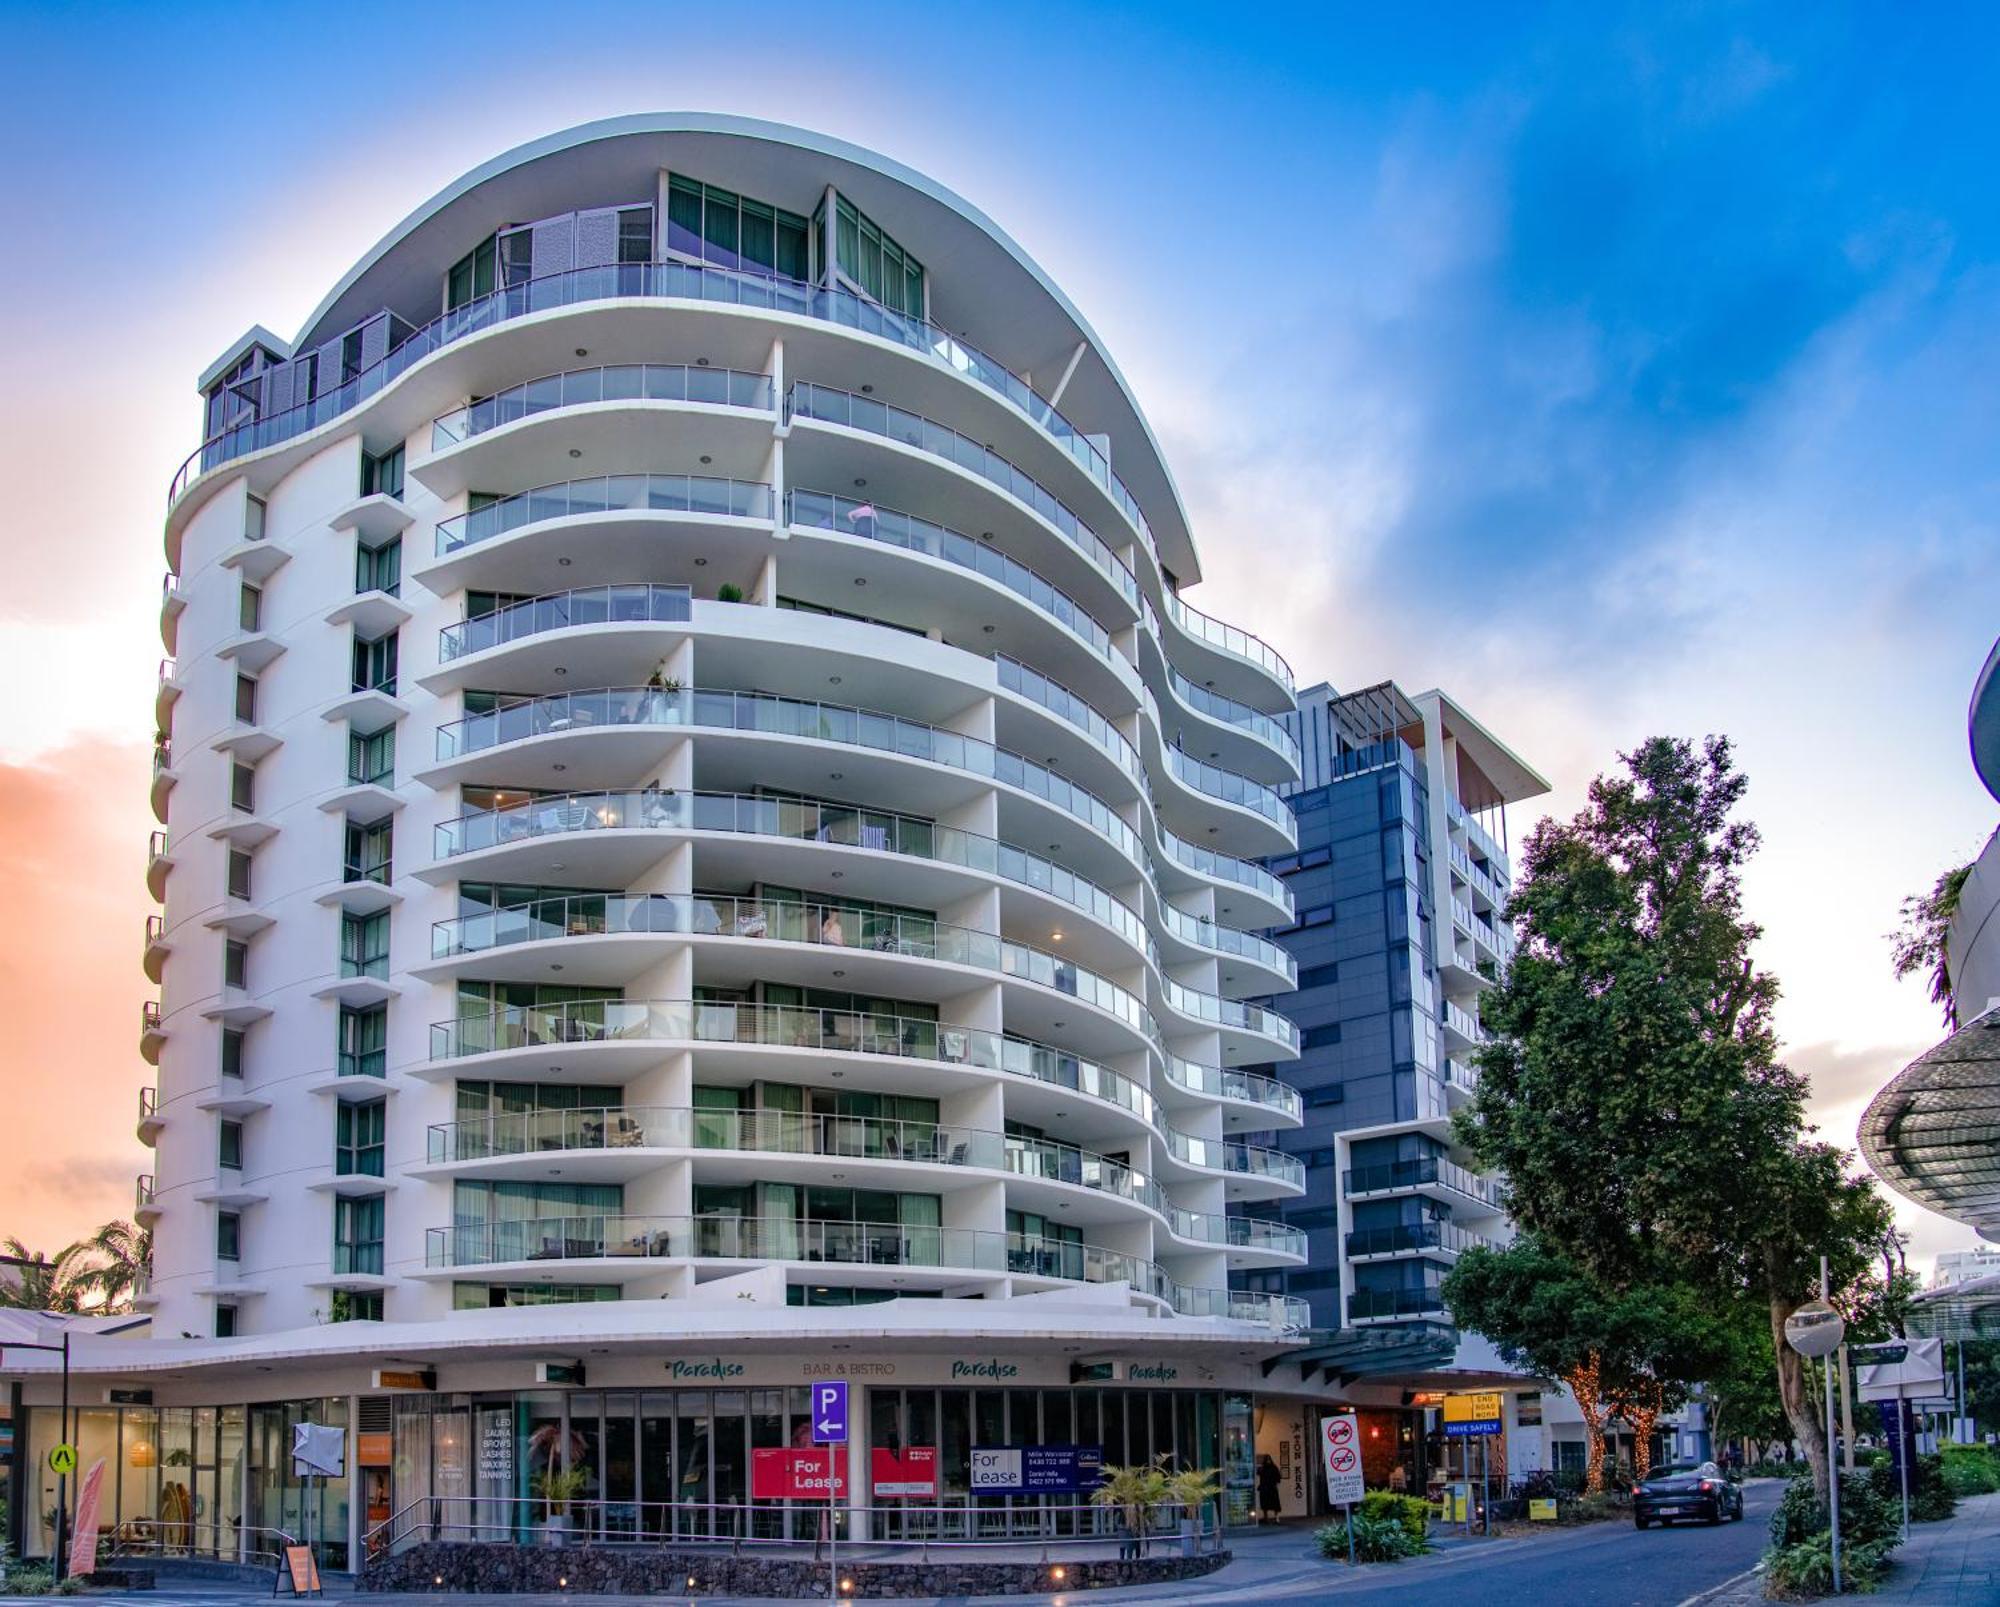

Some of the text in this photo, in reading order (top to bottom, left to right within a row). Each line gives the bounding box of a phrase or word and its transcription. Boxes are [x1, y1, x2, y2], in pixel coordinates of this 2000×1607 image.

[672, 1358, 744, 1381] Paradise
[803, 1363, 896, 1375] BAR & BISTRO
[952, 1359, 1018, 1381] Paradise
[1129, 1362, 1178, 1383] Paradise
[821, 1388, 838, 1415] P
[495, 1418, 511, 1427] LED
[1447, 1423, 1498, 1433] DRIVE SAFELY
[485, 1429, 511, 1437] SAUNA
[482, 1439, 511, 1448] BROWS
[480, 1450, 511, 1458] LASHES
[972, 1452, 999, 1467] For
[480, 1460, 511, 1469] WAXING
[794, 1459, 821, 1473] For
[479, 1470, 511, 1480] TANNING
[973, 1469, 1017, 1484] Lease
[795, 1476, 843, 1489] Lease
